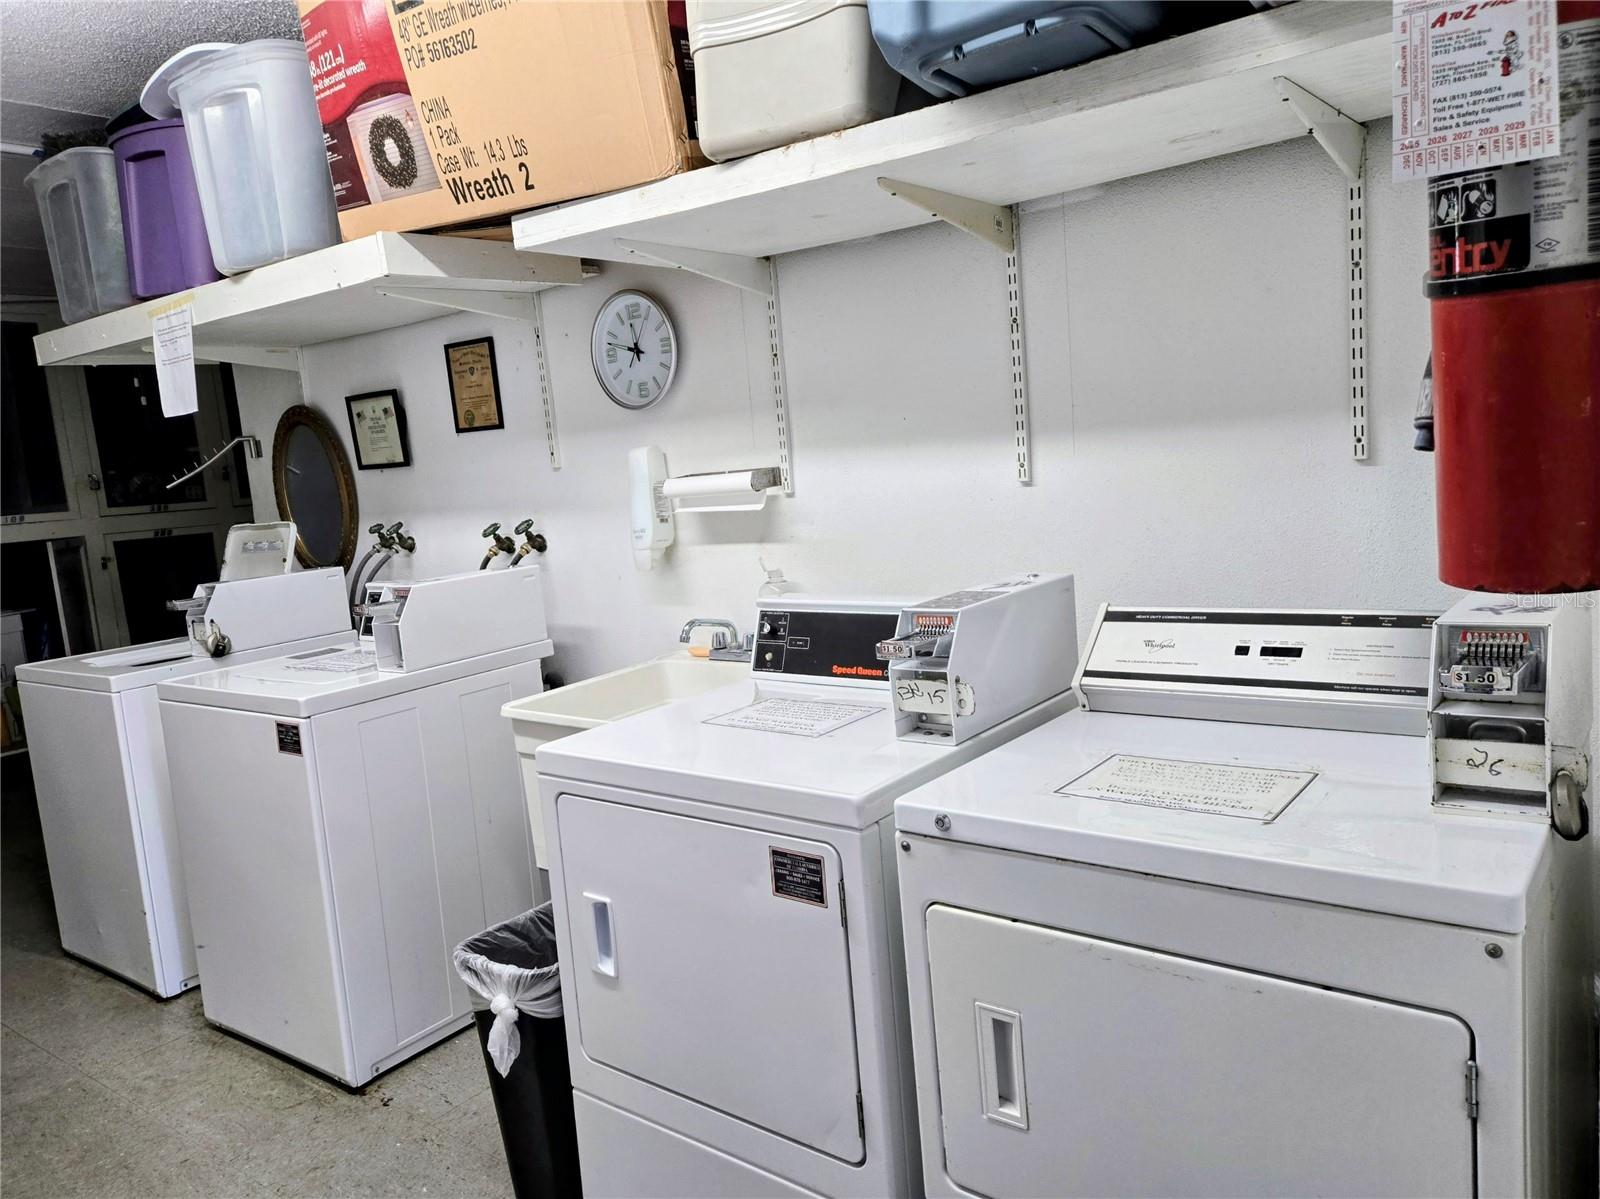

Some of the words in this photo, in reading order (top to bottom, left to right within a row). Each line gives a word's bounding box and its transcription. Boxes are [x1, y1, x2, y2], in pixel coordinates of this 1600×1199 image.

[398, 16, 410, 44] 48"
[412, 12, 428, 38] GE
[424, 2, 460, 32] Wreath
[1431, 12, 1447, 29] A
[1463, 5, 1478, 20] Z
[405, 42, 426, 72] PO#
[426, 28, 478, 63] 56163502
[345, 59, 367, 76] wreath
[421, 96, 452, 124] CHINA
[1433, 97, 1448, 105] FAX
[1433, 106, 1446, 114] Toll
[1433, 116, 1447, 124] Fire
[1456, 110, 1479, 119] Safety
[1481, 102, 1522, 114] Equipment
[429, 128, 437, 150] 1
[437, 122, 462, 148] Pack
[1427, 136, 1448, 146] 2026
[1453, 131, 1473, 141] 2027
[1479, 126, 1499, 137] 2028
[1504, 121, 1526, 132] 2029
[1433, 125, 1453, 133] Sales
[1462, 118, 1490, 128] Service
[1506, 136, 1514, 151] APR
[1533, 132, 1541, 146] FEB
[437, 153, 462, 175] Case
[484, 138, 506, 164] 14.3
[507, 134, 528, 159] Lbs
[1454, 147, 1462, 160] AUG
[446, 168, 515, 205] Wreath
[518, 162, 535, 191] 2
[1430, 237, 1512, 279] entry
[1144, 642, 1176, 650] Whirlpool
[832, 665, 857, 676] Speed
[857, 667, 883, 677] Queen
[927, 689, 947, 705] 15
[1466, 747, 1505, 776] 26
